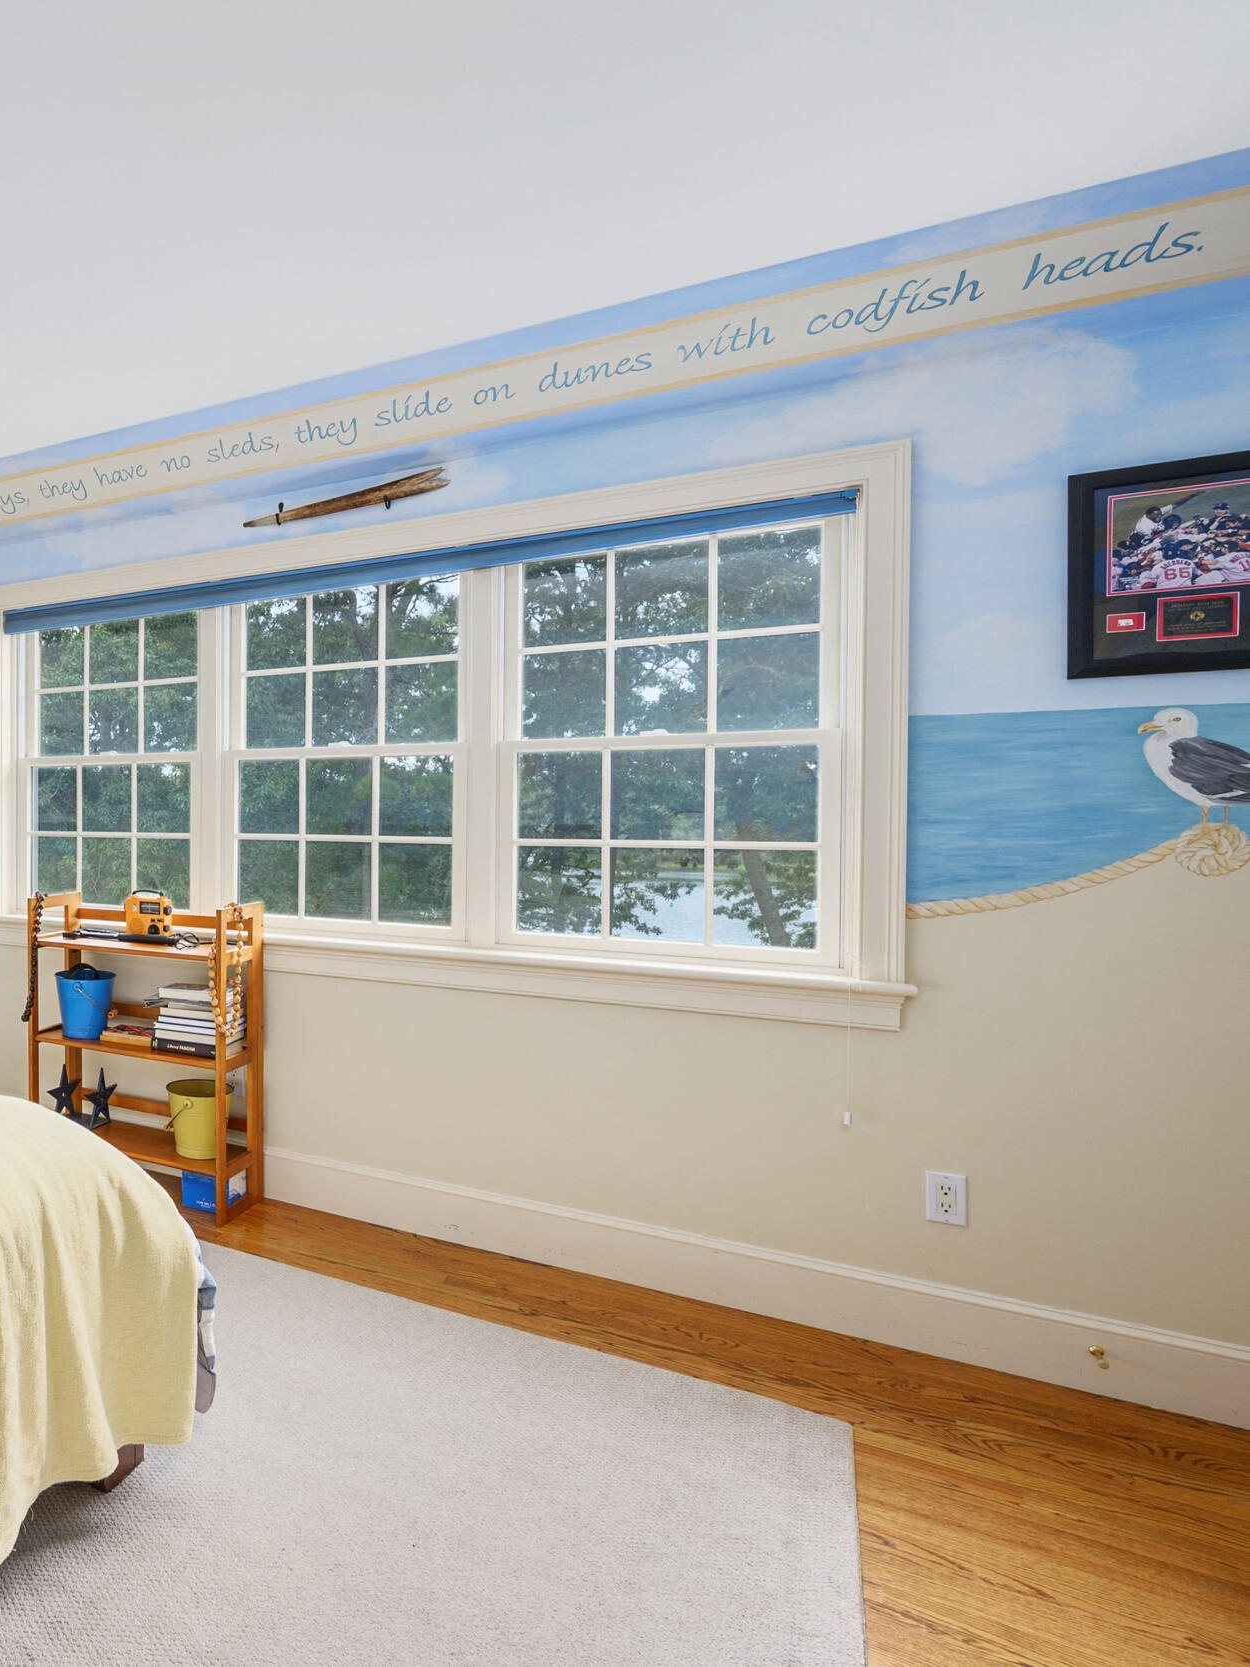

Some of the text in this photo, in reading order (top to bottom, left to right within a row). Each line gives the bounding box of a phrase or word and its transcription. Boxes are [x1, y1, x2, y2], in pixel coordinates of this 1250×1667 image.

[39, 477, 88, 501] they
[95, 464, 148, 488] have
[161, 455, 192, 473] no
[207, 433, 280, 463] sleds,
[295, 415, 358, 446] they
[374, 390, 453, 428] slide
[473, 384, 516, 407] on
[538, 353, 654, 393] dunes
[677, 317, 776, 363] with
[806, 269, 986, 336] codfish
[1022, 221, 1205, 291] heads.
